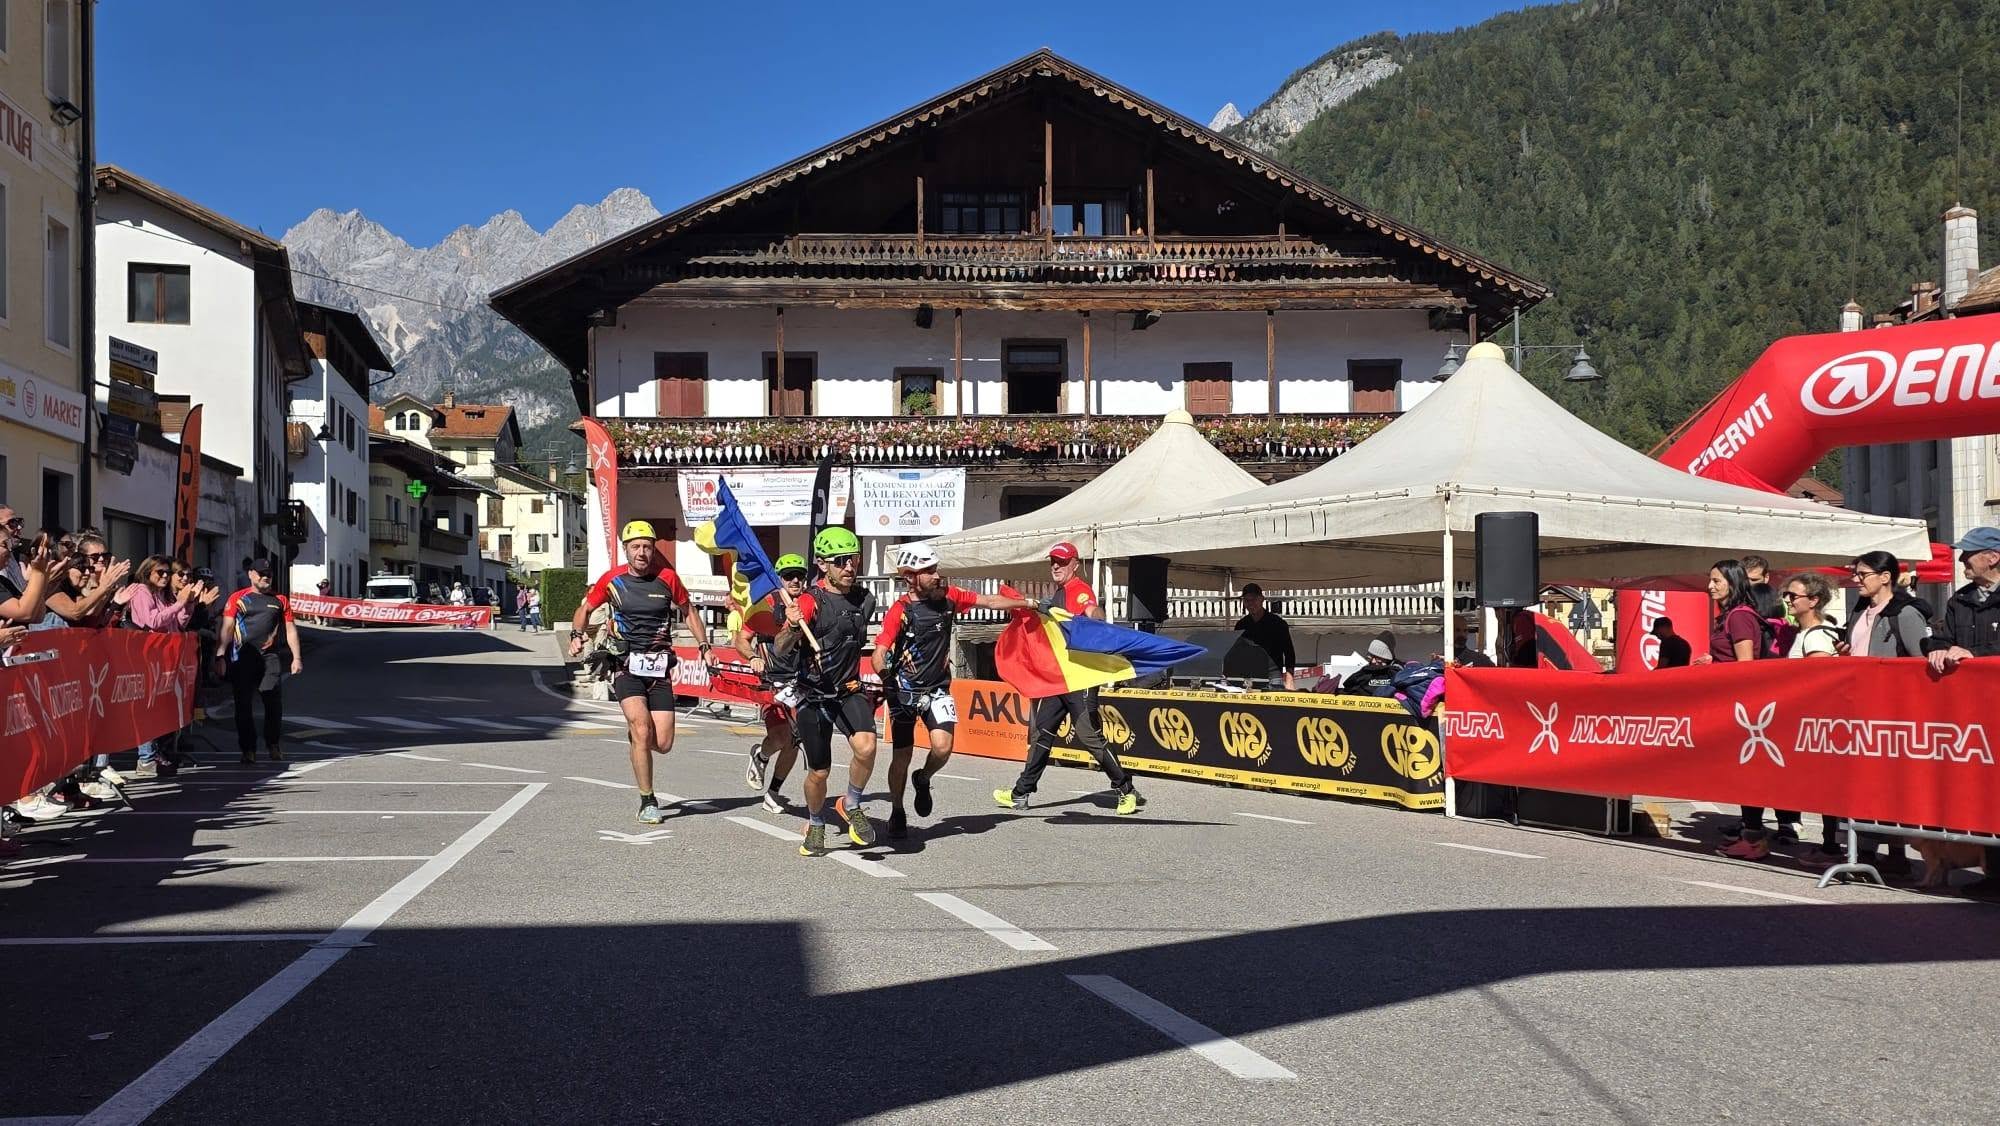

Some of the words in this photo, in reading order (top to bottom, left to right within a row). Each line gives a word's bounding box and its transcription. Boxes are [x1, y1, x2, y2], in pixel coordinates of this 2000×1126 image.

[43, 394, 82, 429] MARKET
[863, 500, 870, 508] A
[873, 500, 902, 508] TUTTI
[904, 500, 920, 508] GLI
[922, 500, 955, 508] ATLETI
[881, 490, 891, 498] IL
[893, 490, 955, 499] BENVENUTO
[361, 606, 412, 621] ENERVIT
[1568, 715, 1695, 748] MONTURA
[1794, 718, 1995, 765] MONTURA
[1257, 745, 1273, 767] ITALY
[1341, 751, 1358, 776] ITALY
